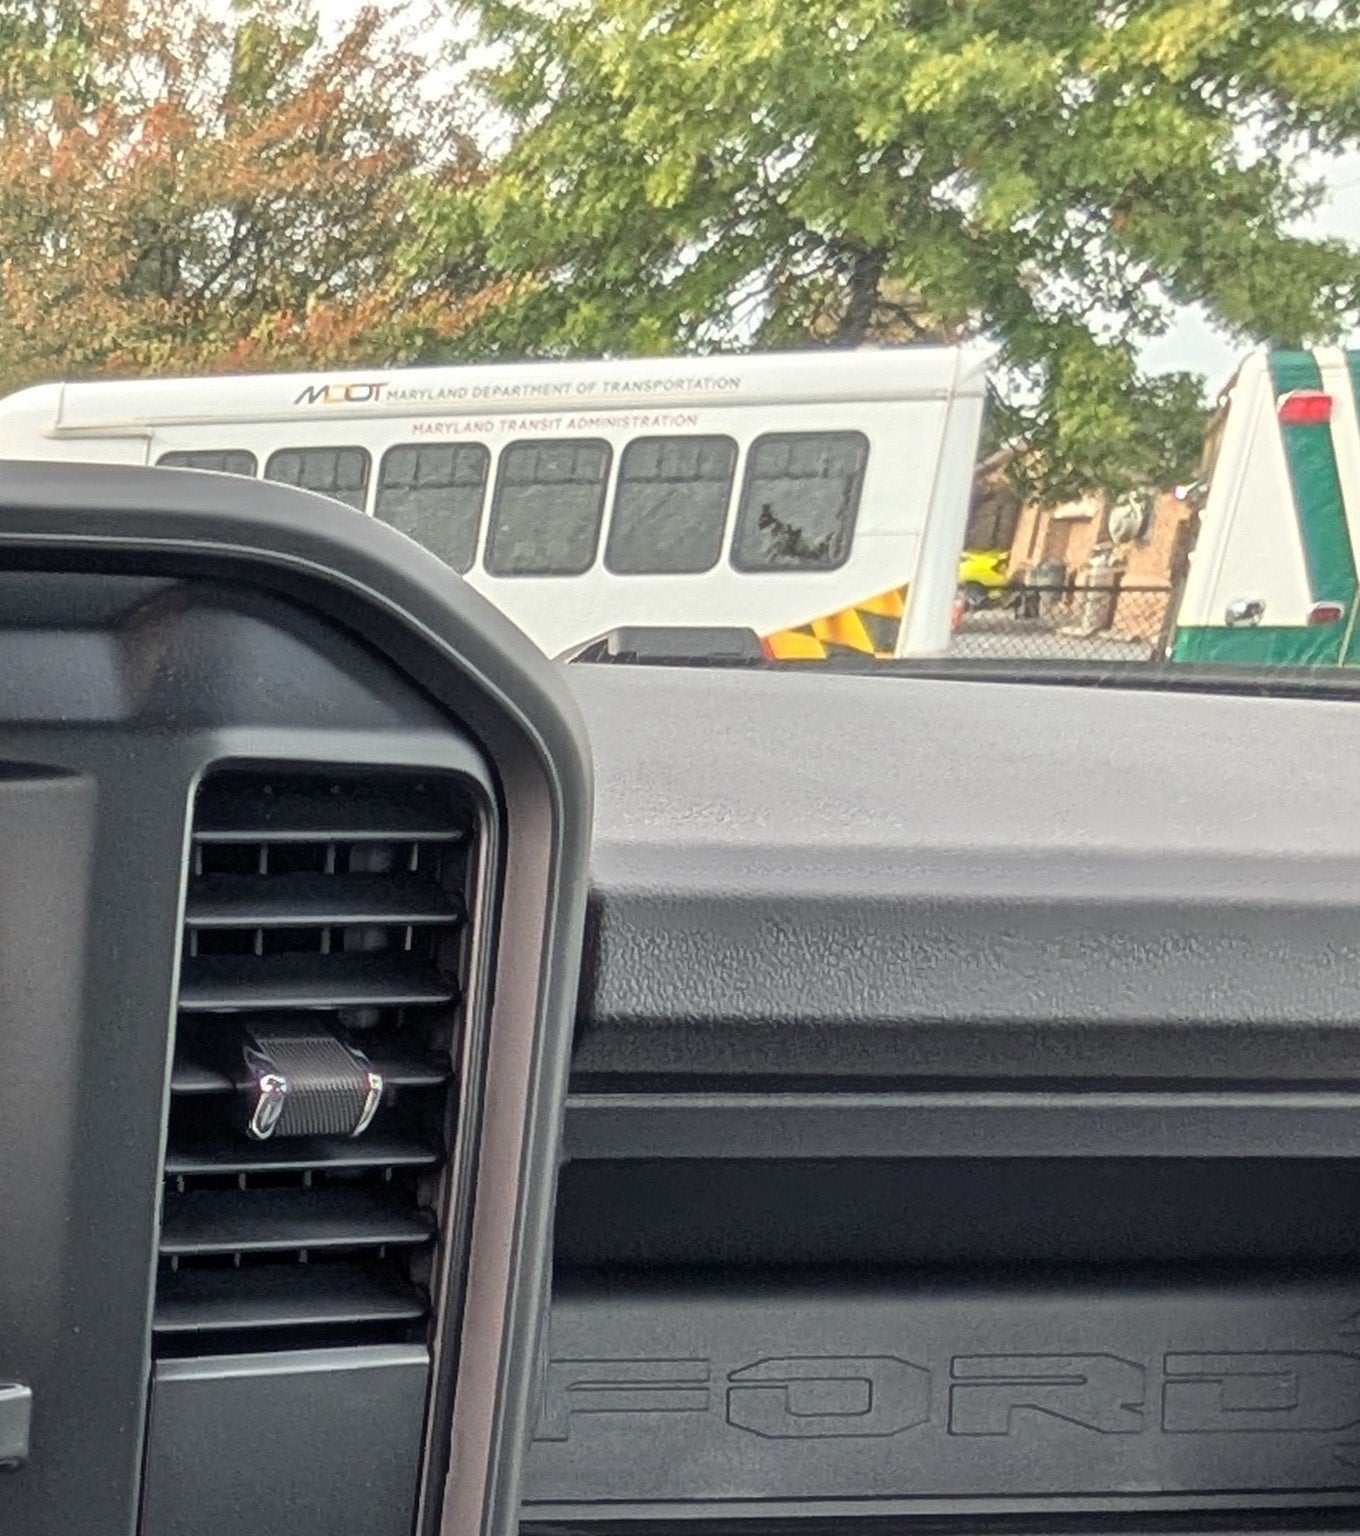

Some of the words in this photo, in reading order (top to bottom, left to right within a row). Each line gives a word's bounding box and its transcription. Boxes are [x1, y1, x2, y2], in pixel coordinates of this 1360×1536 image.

[387, 387, 469, 401] MARYLAND
[471, 382, 572, 399] DEPARTMENT
[576, 381, 595, 395] OF
[602, 376, 743, 393] TRANSPORTATION
[412, 421, 494, 436] MARYLAND
[499, 418, 562, 432] TRANSIT
[566, 413, 699, 431] ADMINISTRATION
[533, 1350, 1360, 1442] FORD
